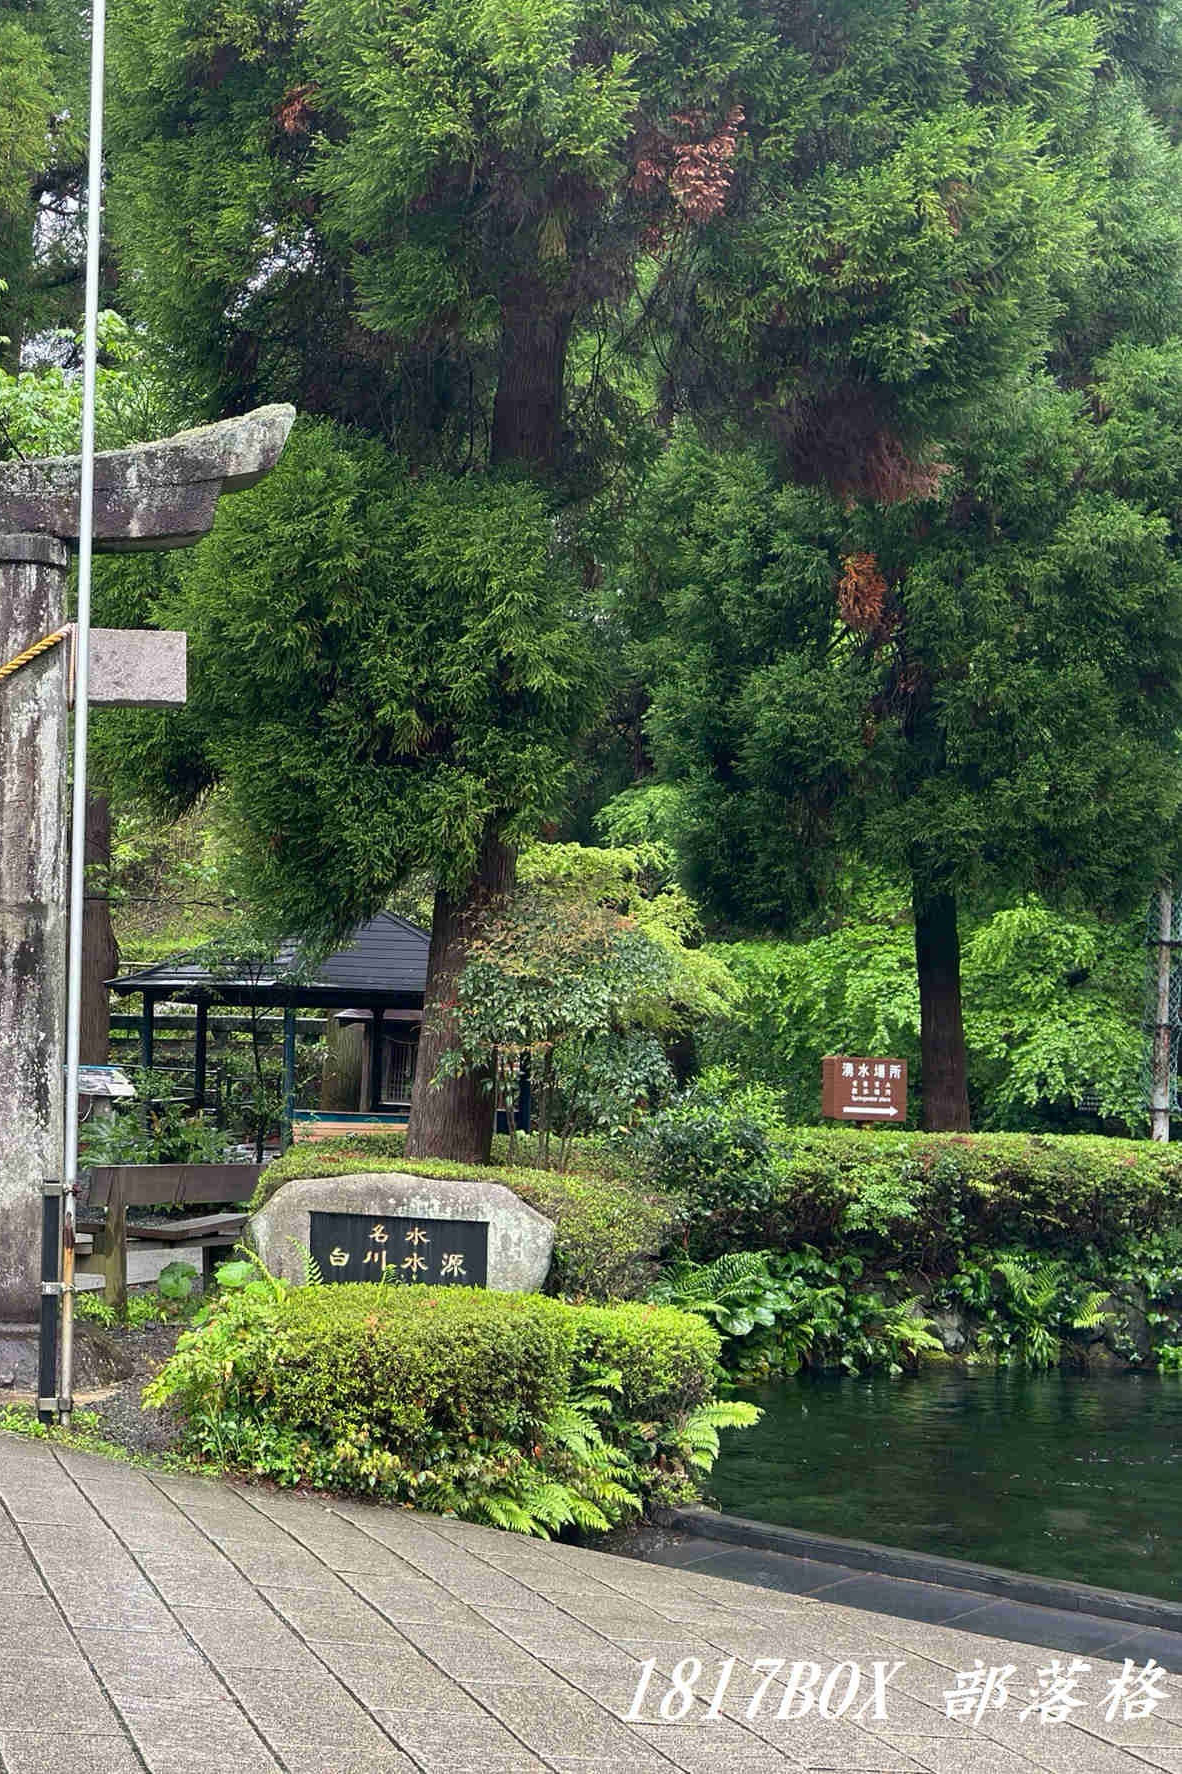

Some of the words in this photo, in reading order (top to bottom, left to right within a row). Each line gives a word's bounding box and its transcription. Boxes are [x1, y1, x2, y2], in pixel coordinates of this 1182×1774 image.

[369, 1223, 431, 1246] 名水
[329, 1248, 467, 1278] 白川水源
